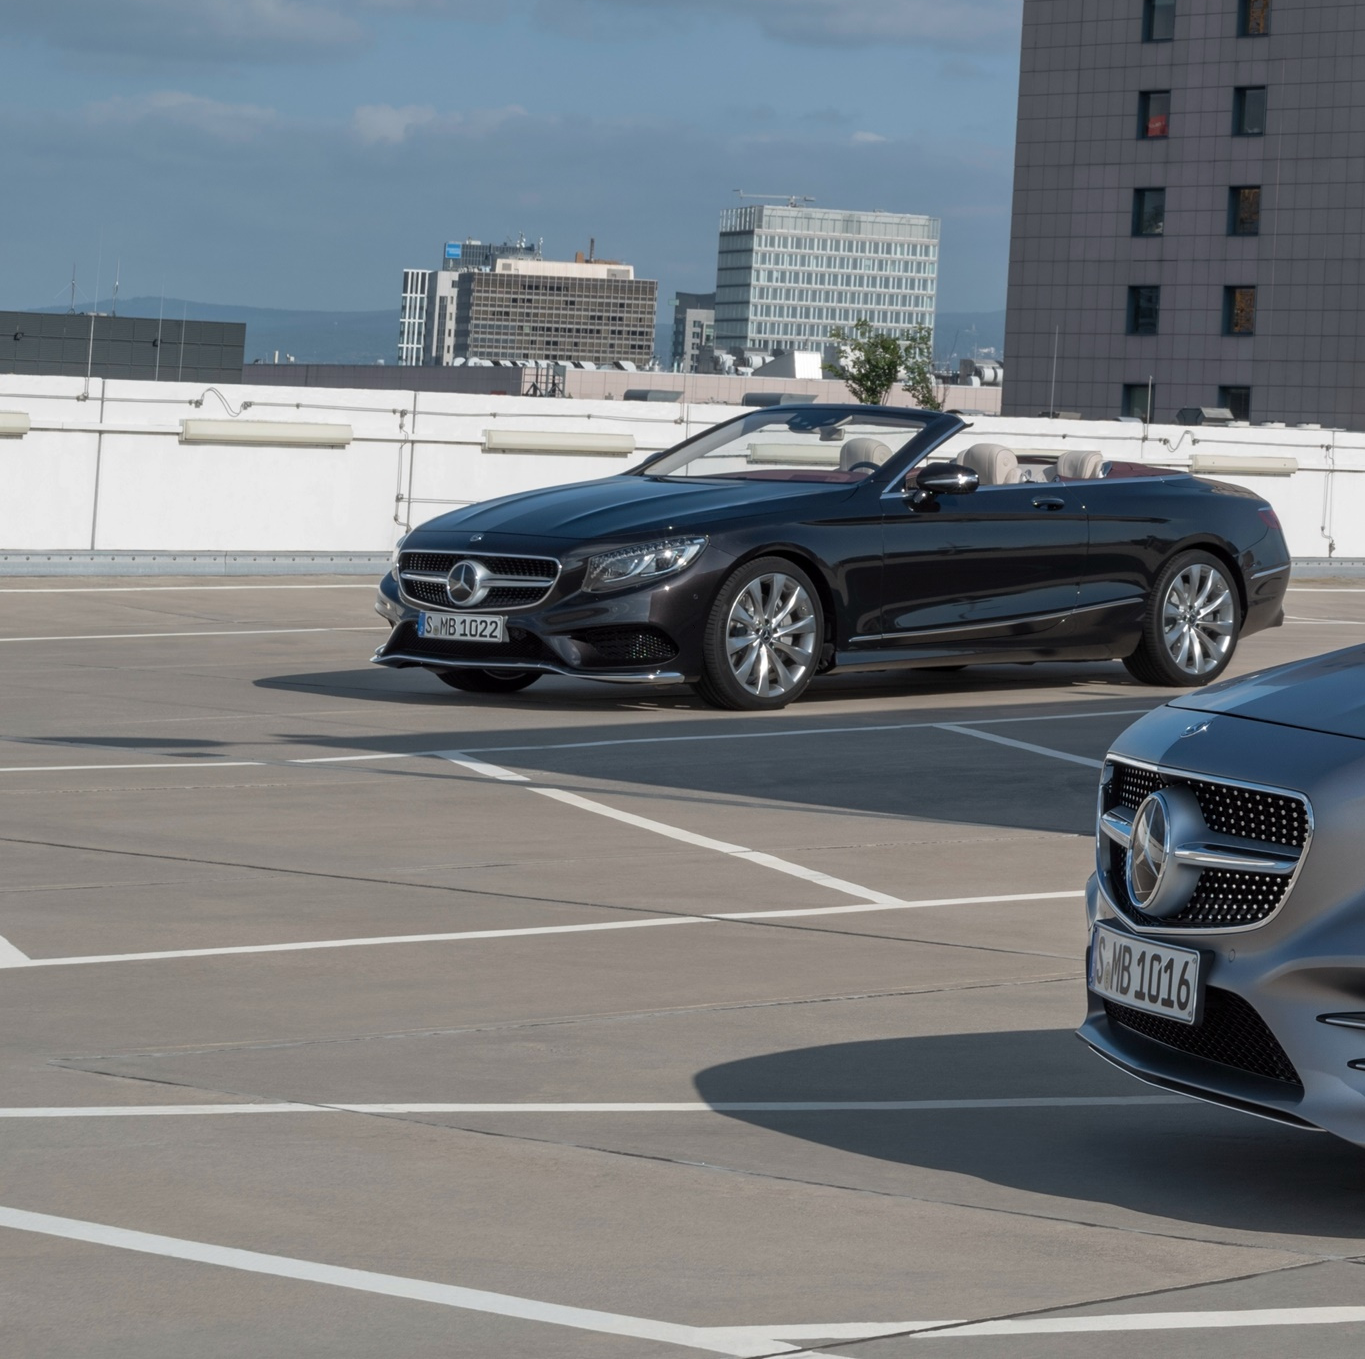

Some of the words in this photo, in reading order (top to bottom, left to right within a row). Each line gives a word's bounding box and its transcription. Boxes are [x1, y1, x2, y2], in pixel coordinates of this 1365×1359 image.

[426, 616, 432, 633] S
[440, 617, 457, 635] MB
[460, 619, 498, 638] 1022
[1096, 936, 1105, 984] S
[1110, 941, 1132, 995] MB
[1134, 950, 1191, 1011] 1016
